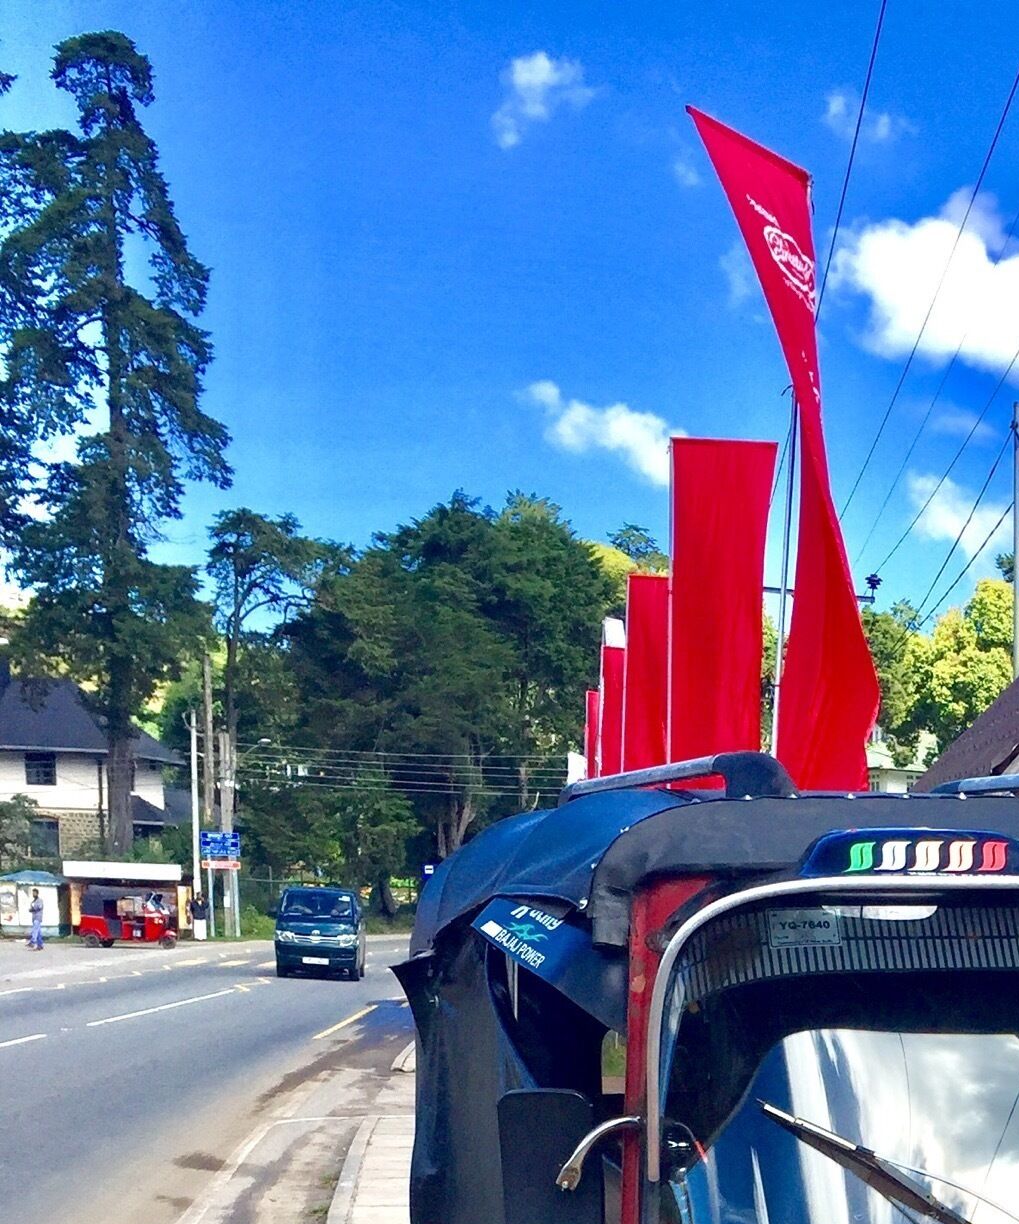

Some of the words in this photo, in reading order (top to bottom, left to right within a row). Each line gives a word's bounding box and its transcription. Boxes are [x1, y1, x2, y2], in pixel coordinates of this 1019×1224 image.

[779, 920, 831, 930] YQ-7640
[495, 928, 521, 953] BAJAJ
[516, 943, 546, 969] POWER
